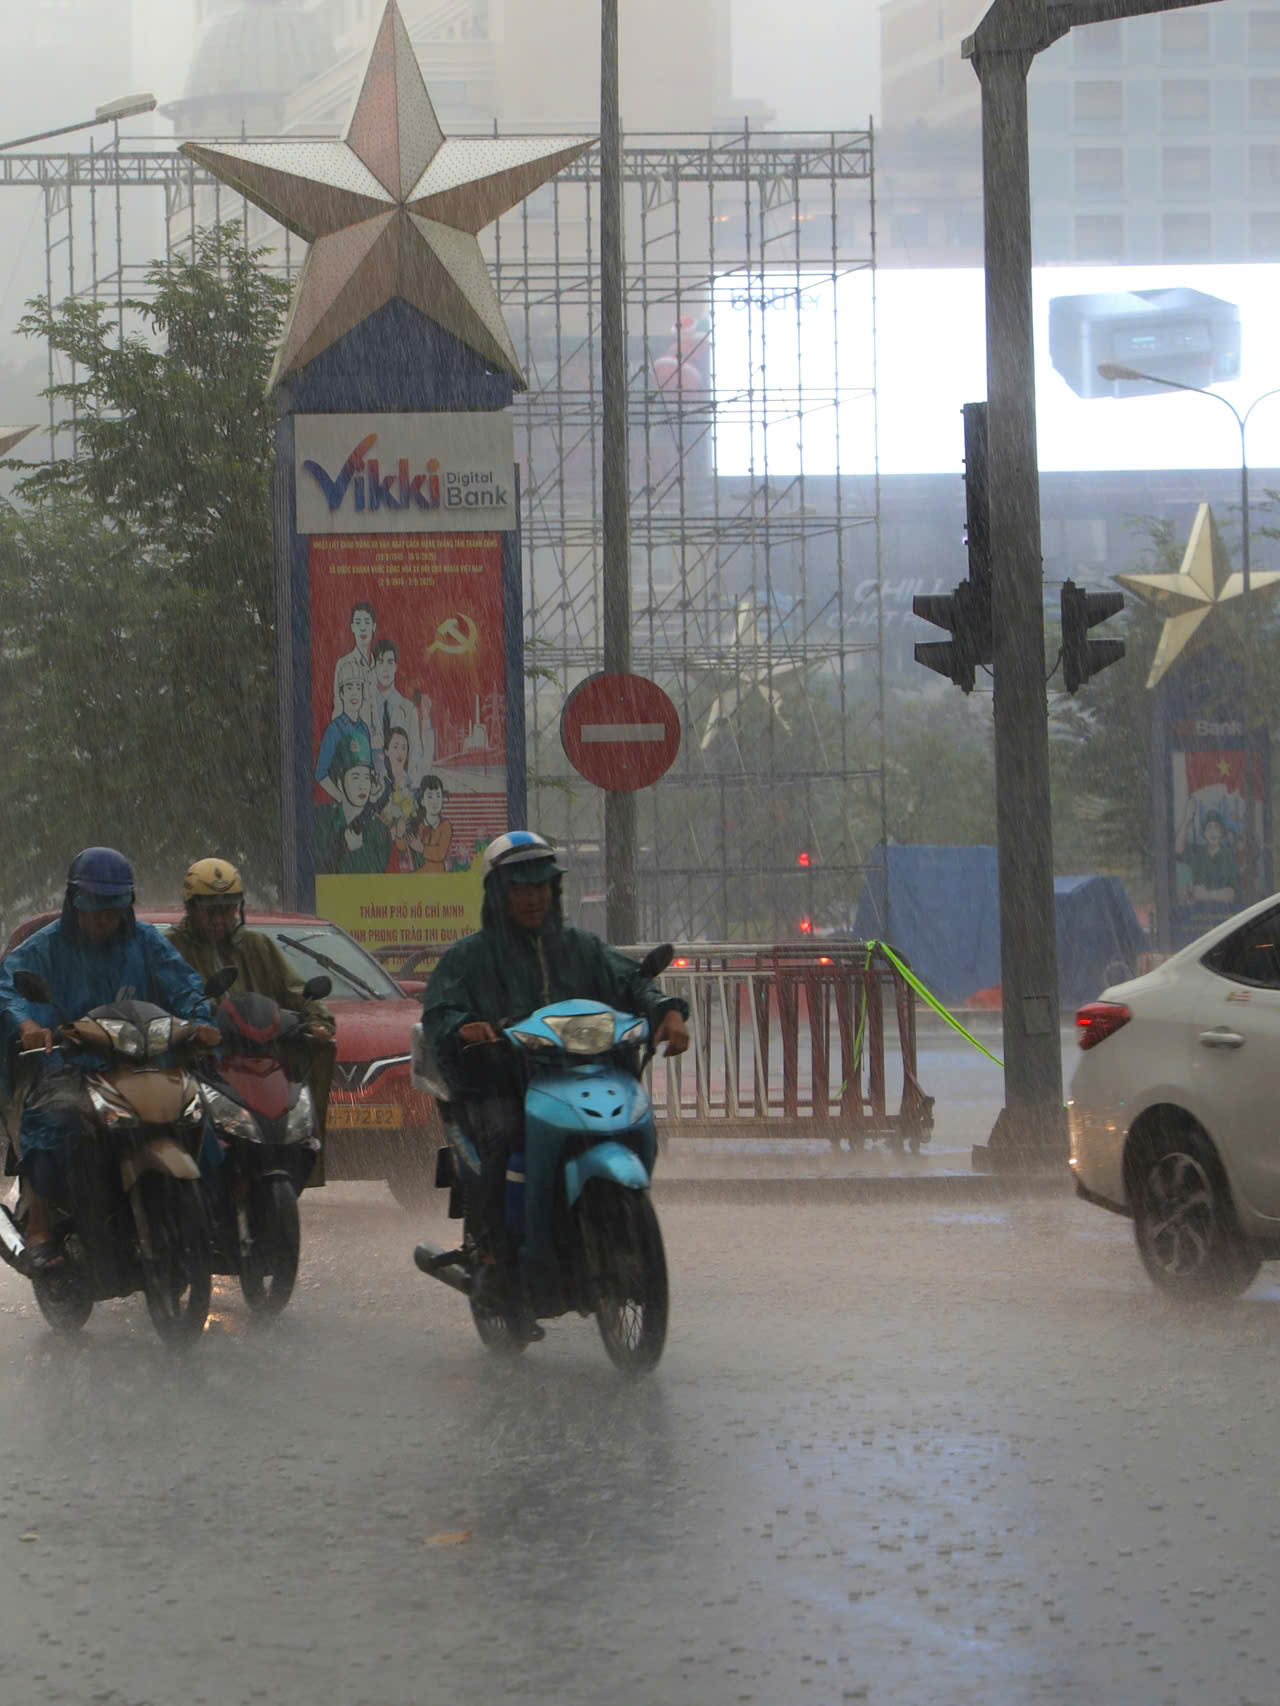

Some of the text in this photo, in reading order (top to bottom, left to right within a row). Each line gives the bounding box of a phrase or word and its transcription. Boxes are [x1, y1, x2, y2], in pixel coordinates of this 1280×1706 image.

[303, 432, 441, 512] Vikki
[446, 470, 494, 487] Digital
[446, 484, 509, 507] Bank
[442, 904, 465, 919] MINH
[368, 928, 398, 942] PHONG
[424, 928, 438, 942] THI
